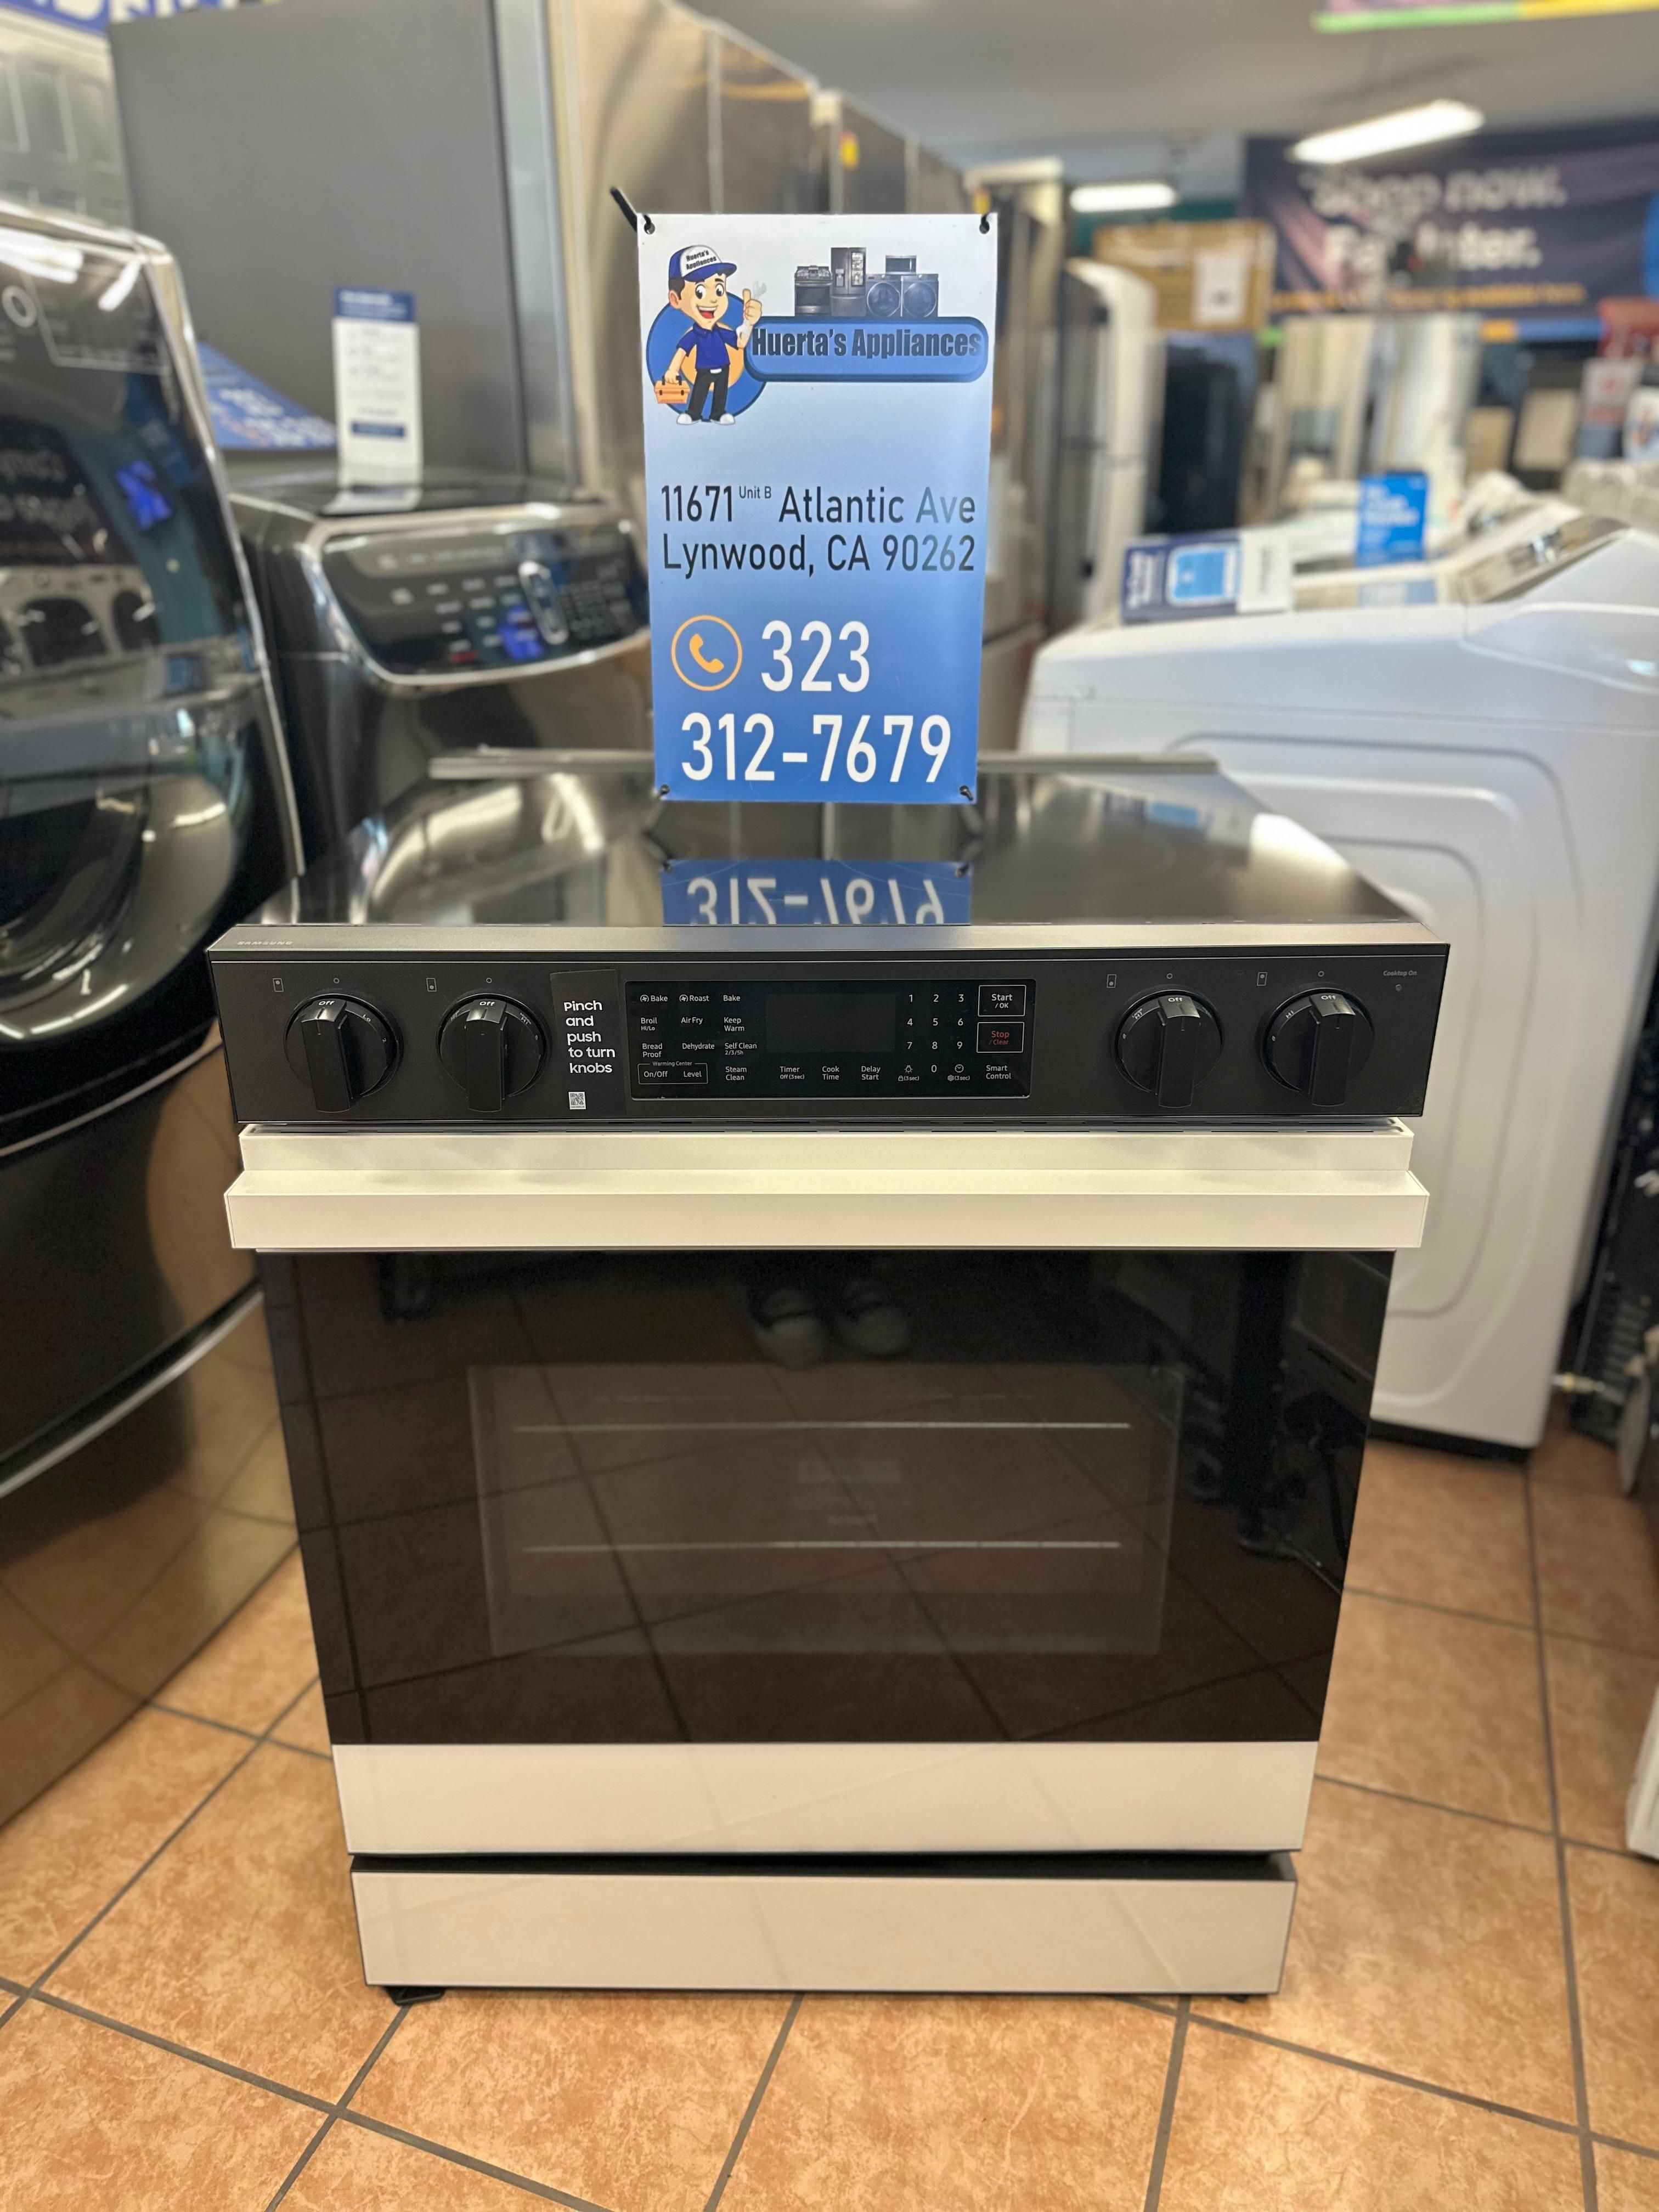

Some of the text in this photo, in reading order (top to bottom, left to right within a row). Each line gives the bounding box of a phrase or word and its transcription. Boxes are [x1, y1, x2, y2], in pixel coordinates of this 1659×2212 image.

[752, 329, 982, 359] Huerta's Appliances
[661, 486, 975, 523] 11671 Unit B Atlantic Ave
[663, 533, 975, 579] Lynwood, CA 90262
[761, 620, 870, 692] 323
[681, 712, 951, 782] 312-7679
[563, 1000, 603, 1012] Pinch
[363, 1014, 371, 1022] Lo
[566, 1015, 594, 1026] and
[567, 1031, 601, 1045] push
[568, 1047, 616, 1058] to turn
[569, 1063, 613, 1074] knobs
